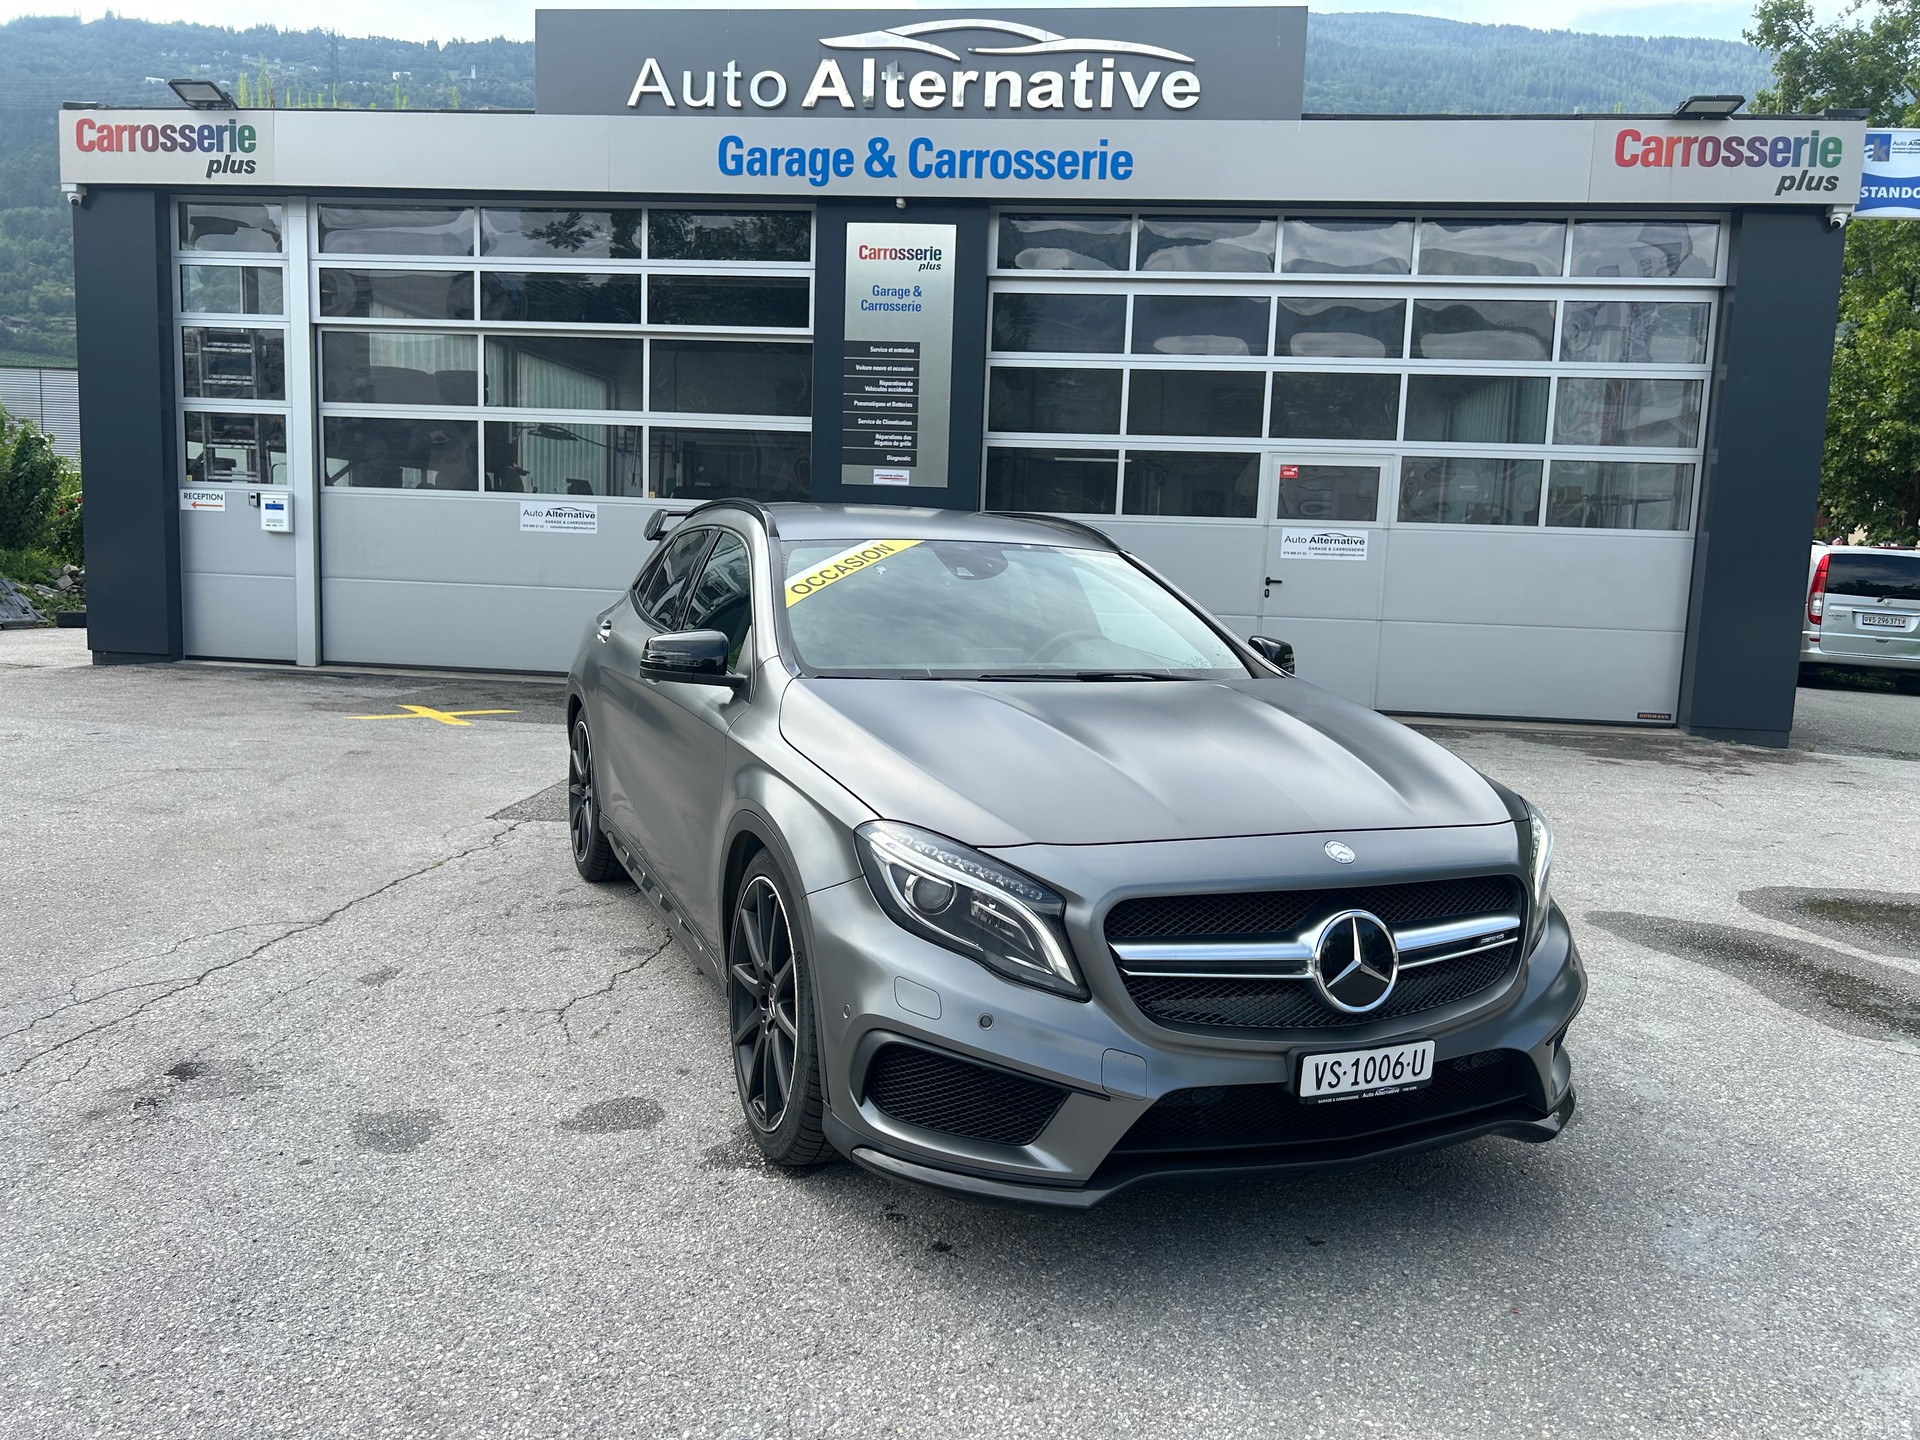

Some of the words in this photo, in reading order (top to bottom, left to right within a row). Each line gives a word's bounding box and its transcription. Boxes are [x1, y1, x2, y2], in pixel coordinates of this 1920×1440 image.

[626, 57, 787, 109] Auto
[800, 57, 1201, 110] Alternative
[75, 118, 256, 154] Carrosserie
[206, 154, 256, 178] plus
[718, 135, 854, 186] Garage
[864, 136, 897, 178] &
[908, 138, 1134, 181] Carrosserie
[1615, 129, 1842, 168] Carrosserie
[1774, 170, 1839, 196] plus
[859, 245, 942, 260] Carrosserie
[918, 262, 942, 272] plus
[872, 284, 910, 299] Garage
[913, 286, 922, 297] &
[861, 300, 922, 312] Carrosserie
[184, 492, 223, 501] RECEPTION
[545, 510, 595, 519] Alternative
[1309, 536, 1365, 545] Alternative
[790, 544, 895, 594] OCCASION
